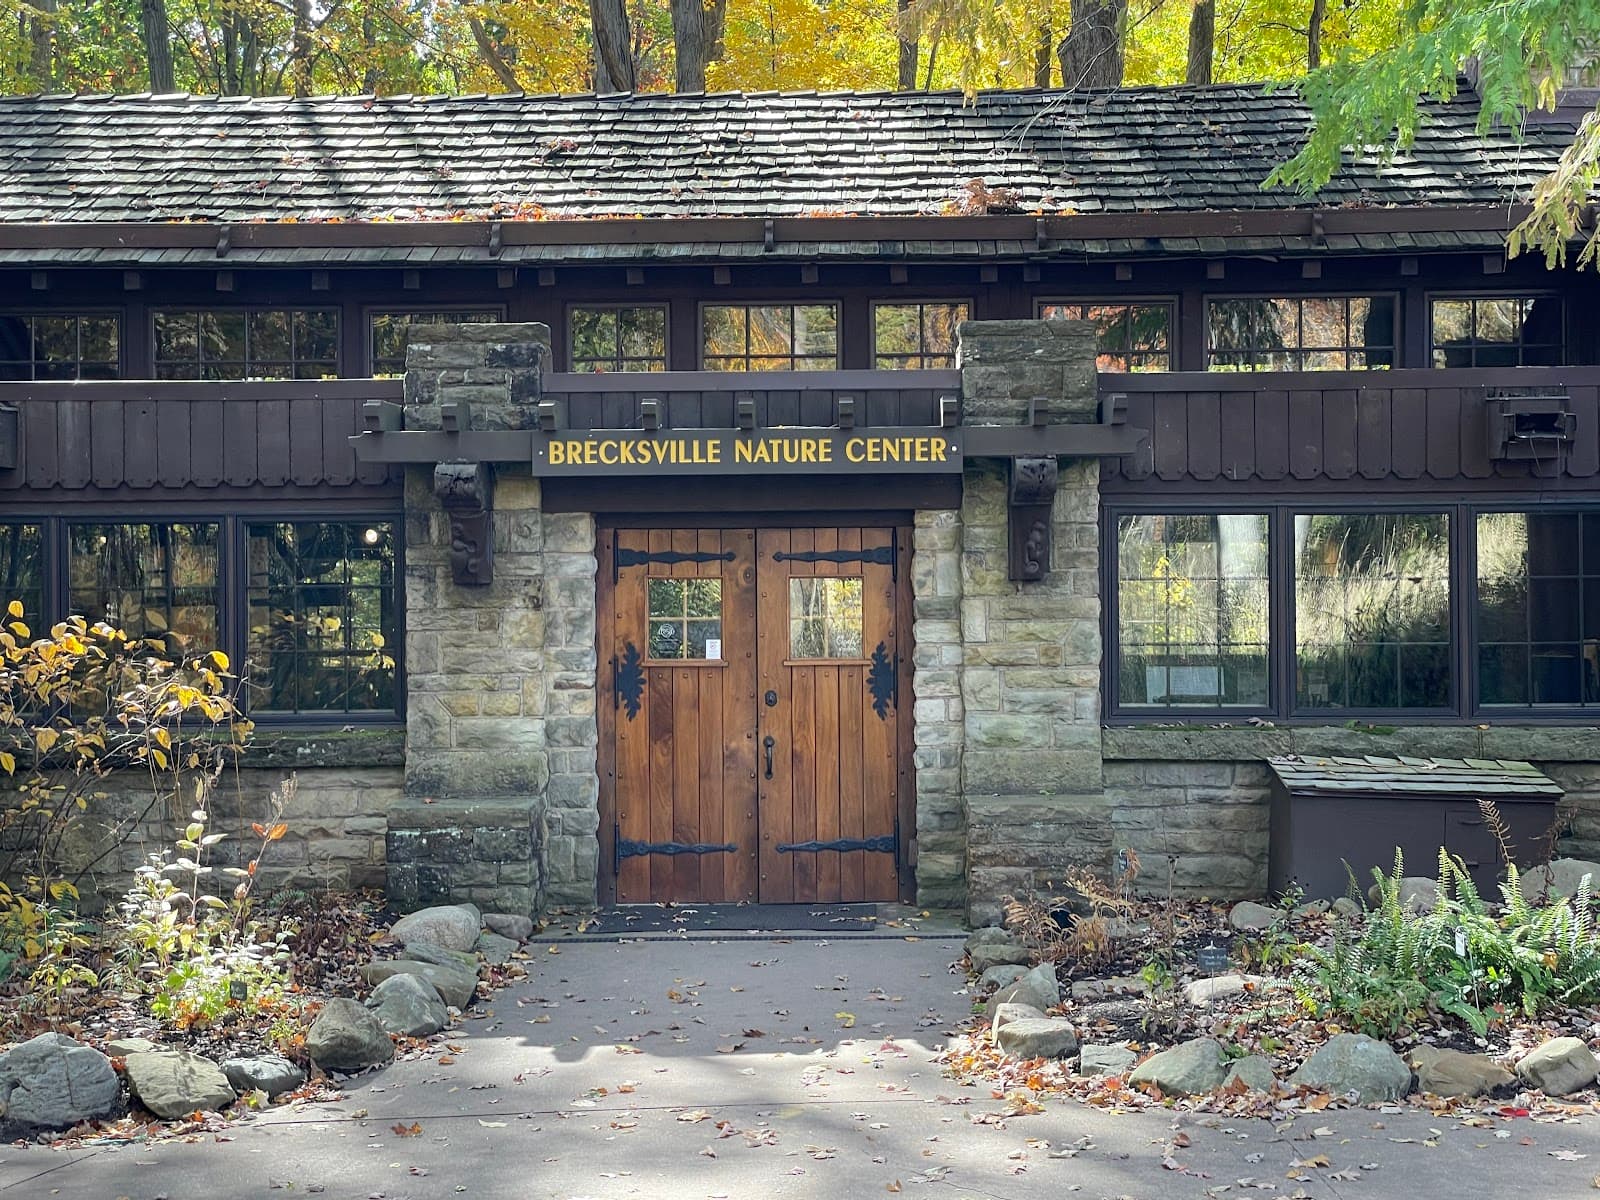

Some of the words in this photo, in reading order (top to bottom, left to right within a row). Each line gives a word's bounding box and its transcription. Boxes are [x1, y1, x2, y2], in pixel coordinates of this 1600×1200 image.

[548, 439, 721, 466] BRECKSVILLE
[733, 438, 833, 464] NATURE
[845, 436, 948, 463] CENTER
